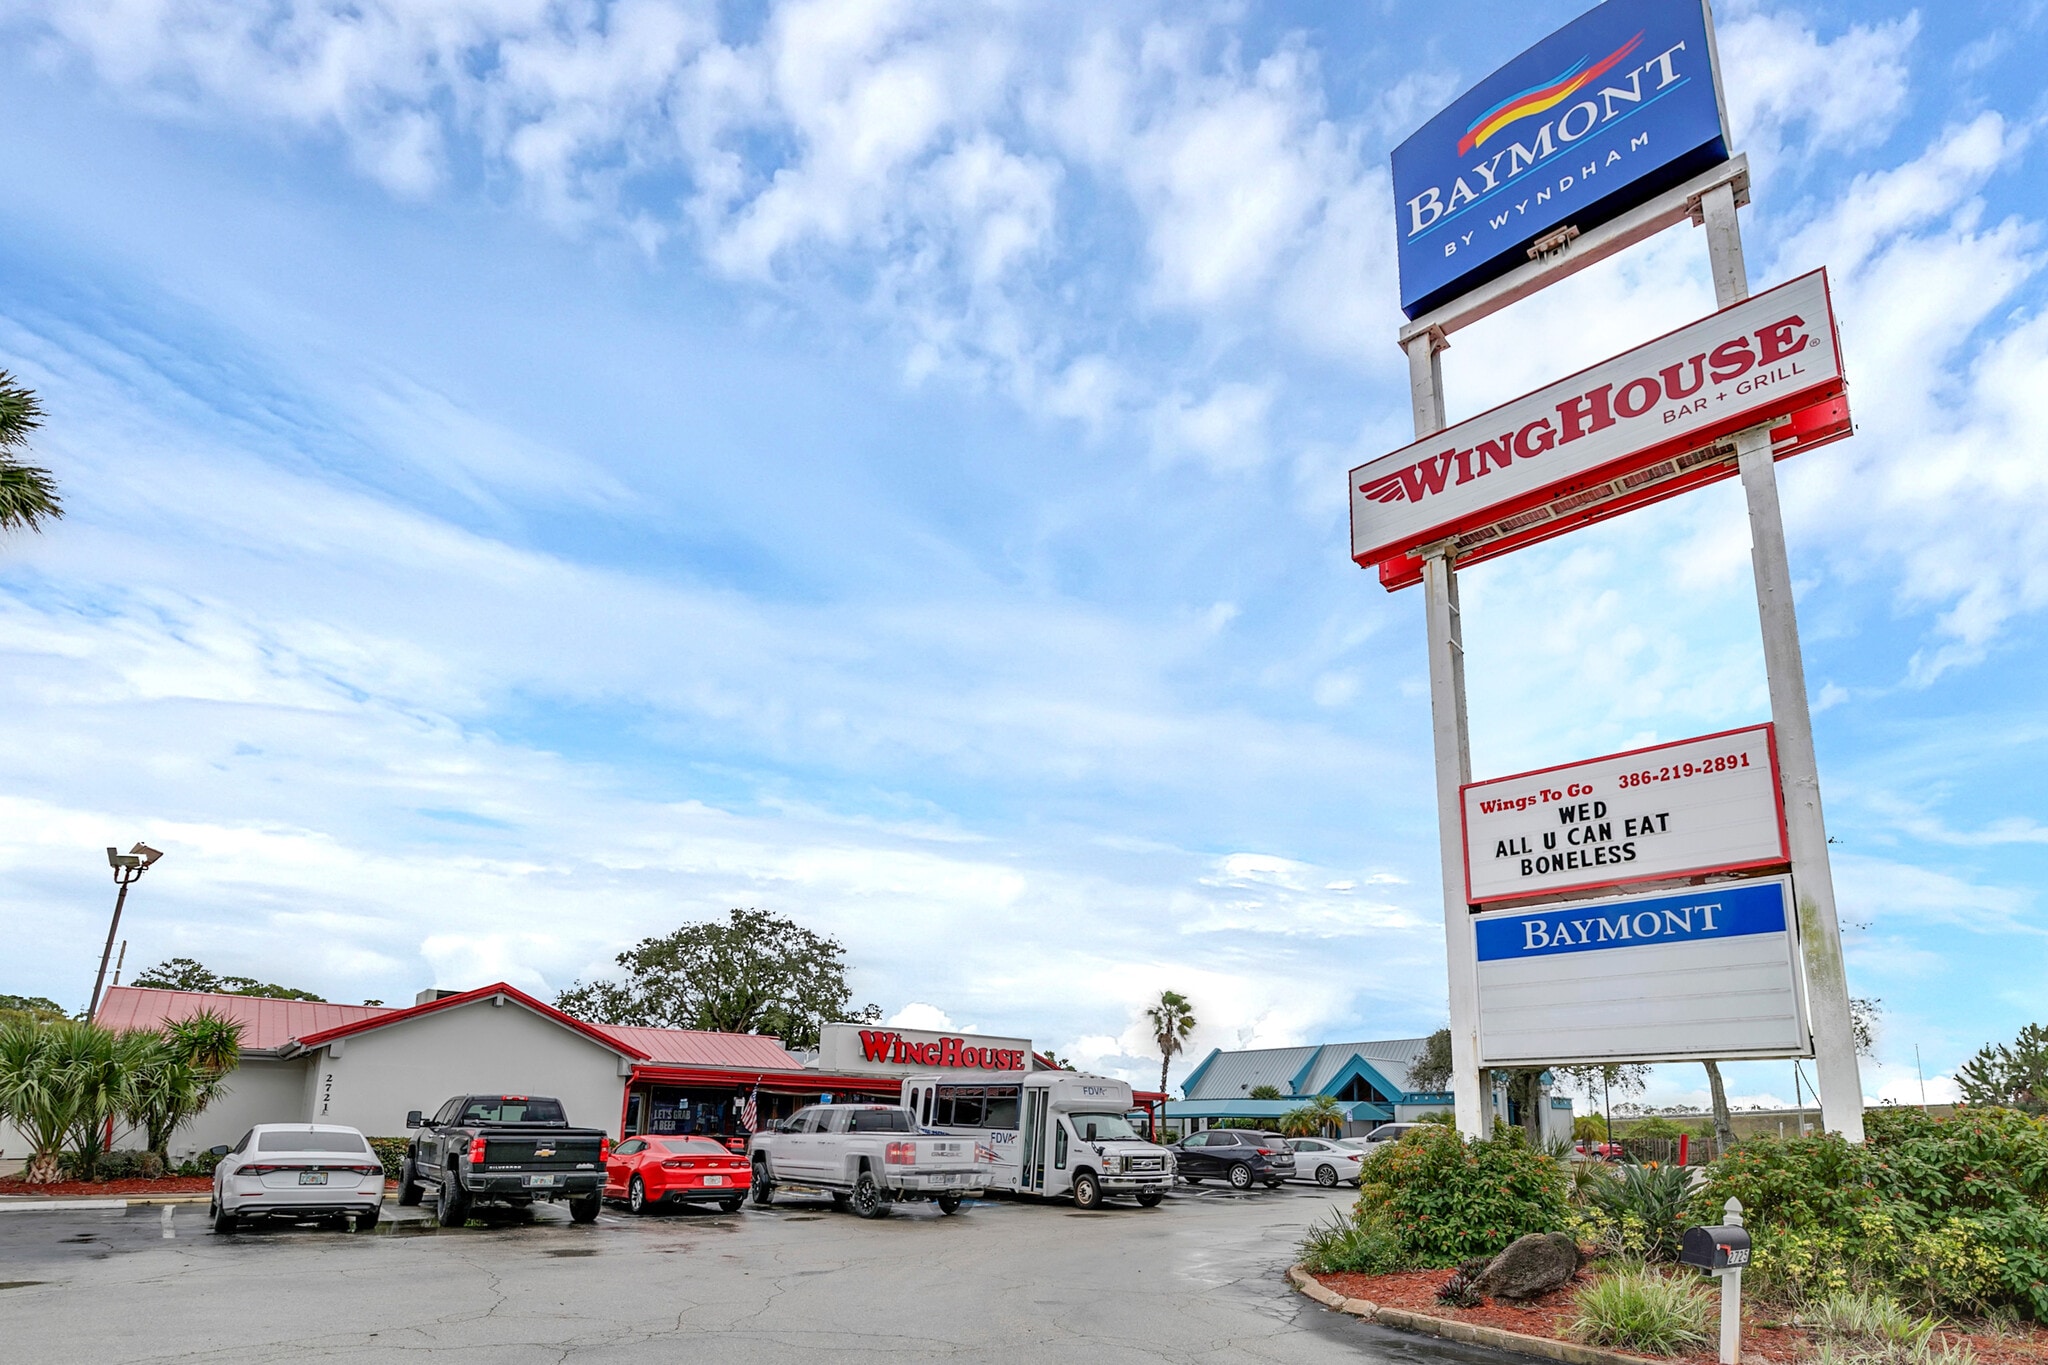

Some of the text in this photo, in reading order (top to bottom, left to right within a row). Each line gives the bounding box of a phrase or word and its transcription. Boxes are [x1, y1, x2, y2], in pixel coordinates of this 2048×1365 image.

[1406, 40, 1686, 237] BAYMONT
[1444, 131, 1649, 257] BY WYNDHAM
[1400, 315, 1809, 503] WINGHOUSE
[1663, 398, 1707, 424] BAR
[1736, 361, 1806, 396] GRILL
[1480, 752, 1751, 815] Wings To Go 386-219-2891
[1558, 801, 1608, 825] WED
[1495, 812, 1670, 858] ALL U CAN EAT
[1520, 842, 1637, 877] BONELESS
[1522, 903, 1722, 951] BAYMONT
[859, 1030, 1025, 1071] WINGHOUSE
[323, 1073, 333, 1111] 2721
[653, 1109, 691, 1120] LET'S GRAB
[659, 1121, 676, 1130] BEER
[1728, 1249, 1749, 1264] 2725
